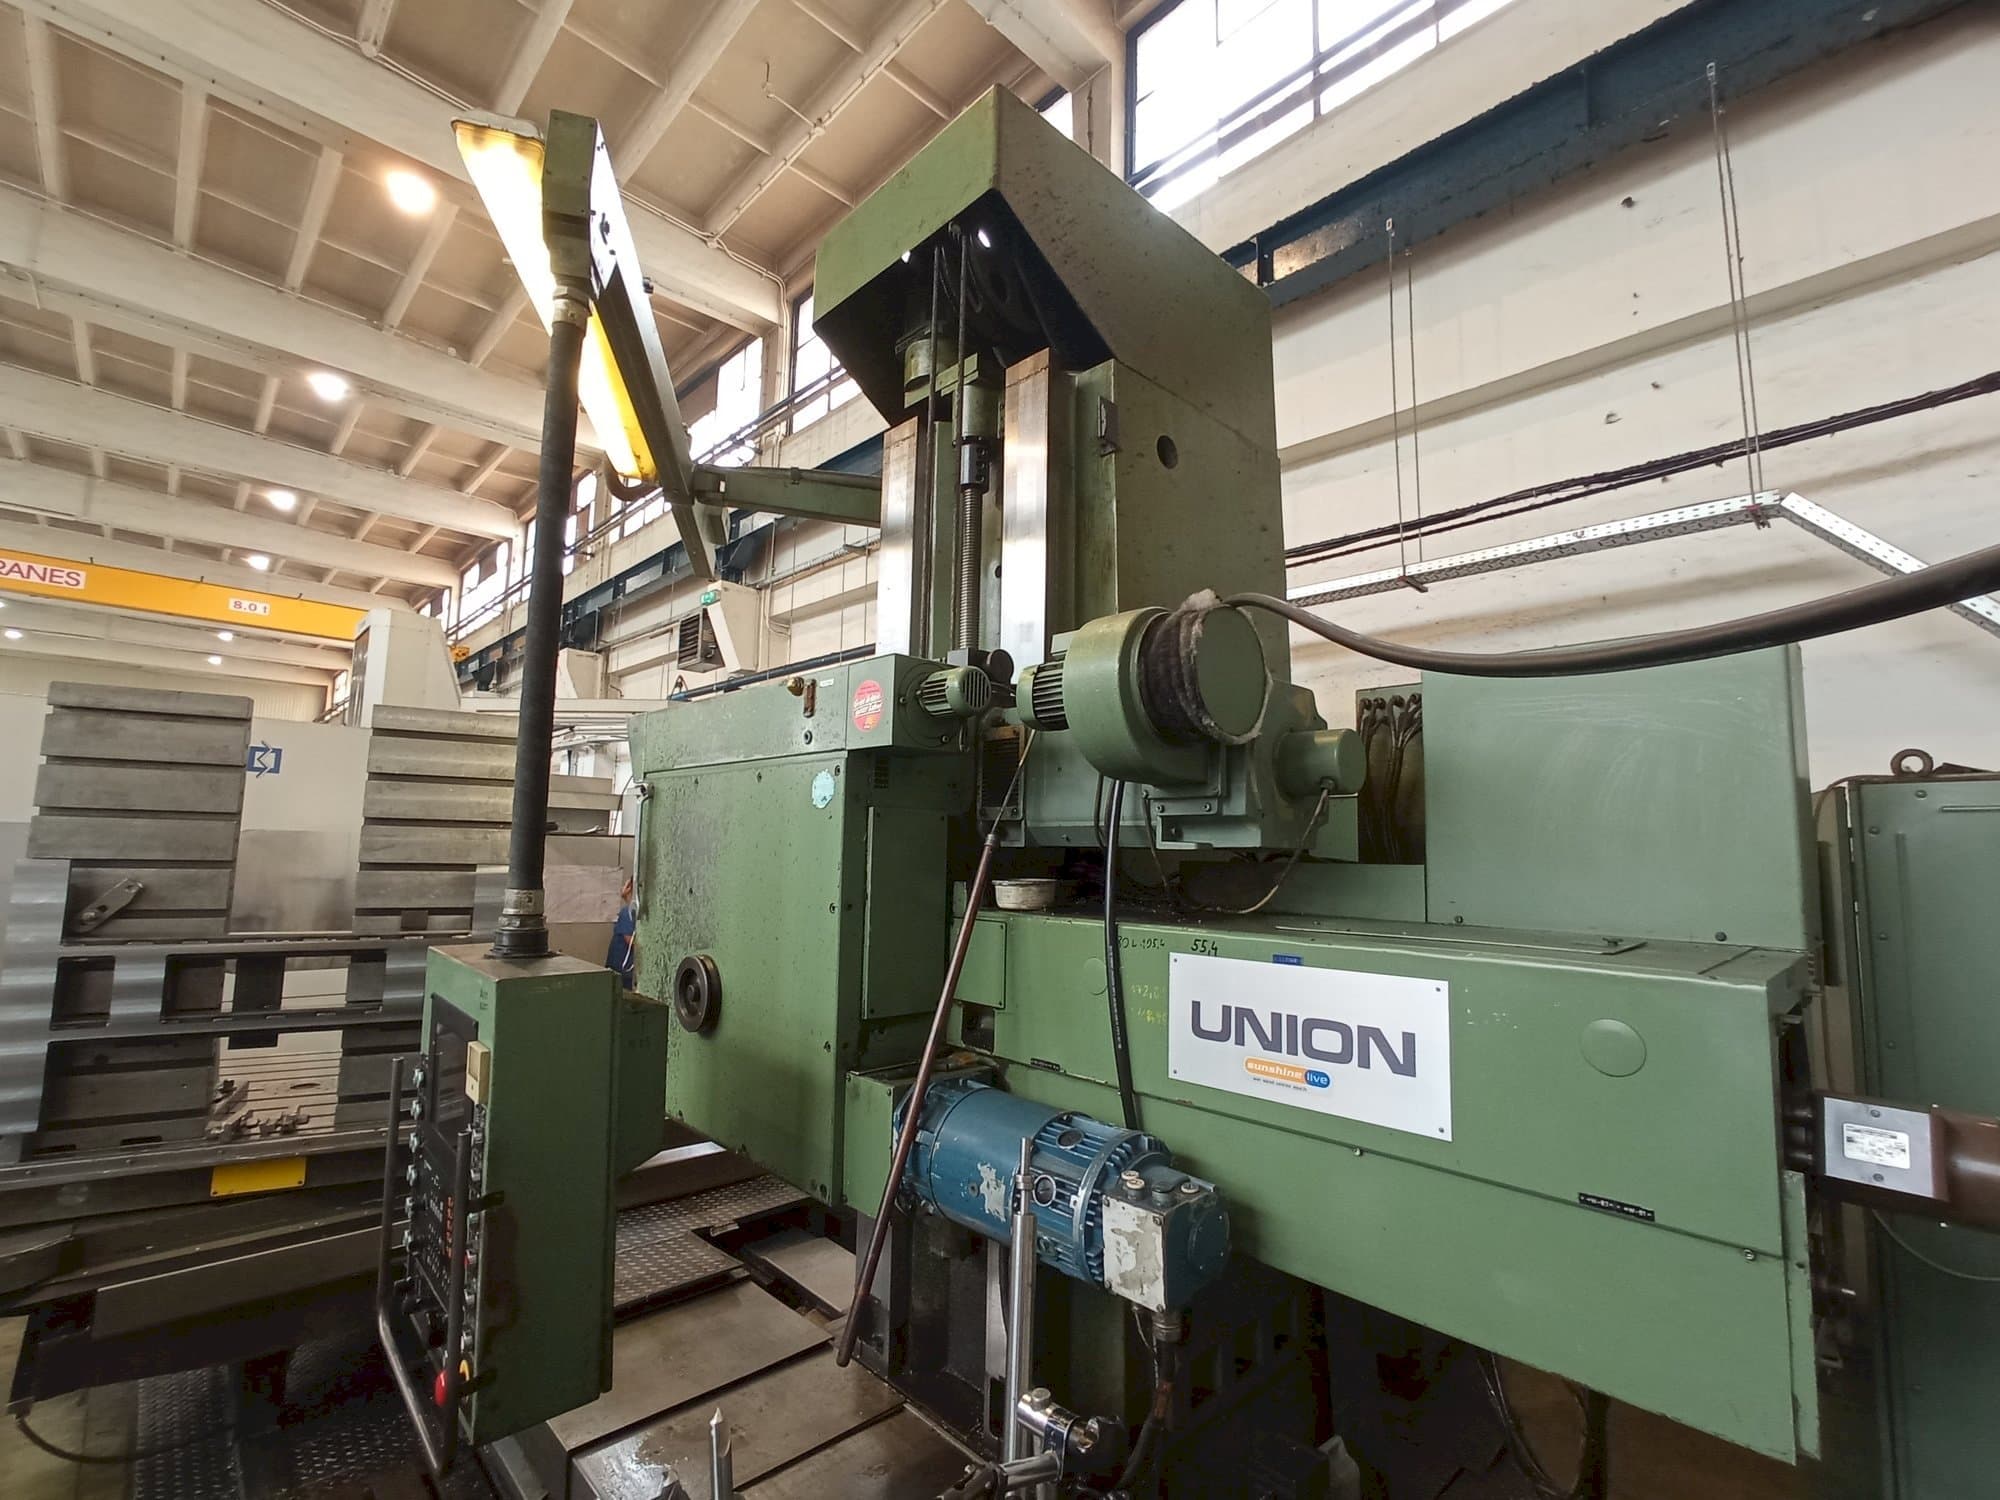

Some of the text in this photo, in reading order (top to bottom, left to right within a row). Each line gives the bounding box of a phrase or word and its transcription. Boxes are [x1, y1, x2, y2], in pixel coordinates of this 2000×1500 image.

[233, 600, 257, 611] 8.0
[1191, 1000, 1417, 1078] UNION
[1246, 1061, 1303, 1078] sunshine
[1306, 1071, 1328, 1086] live
